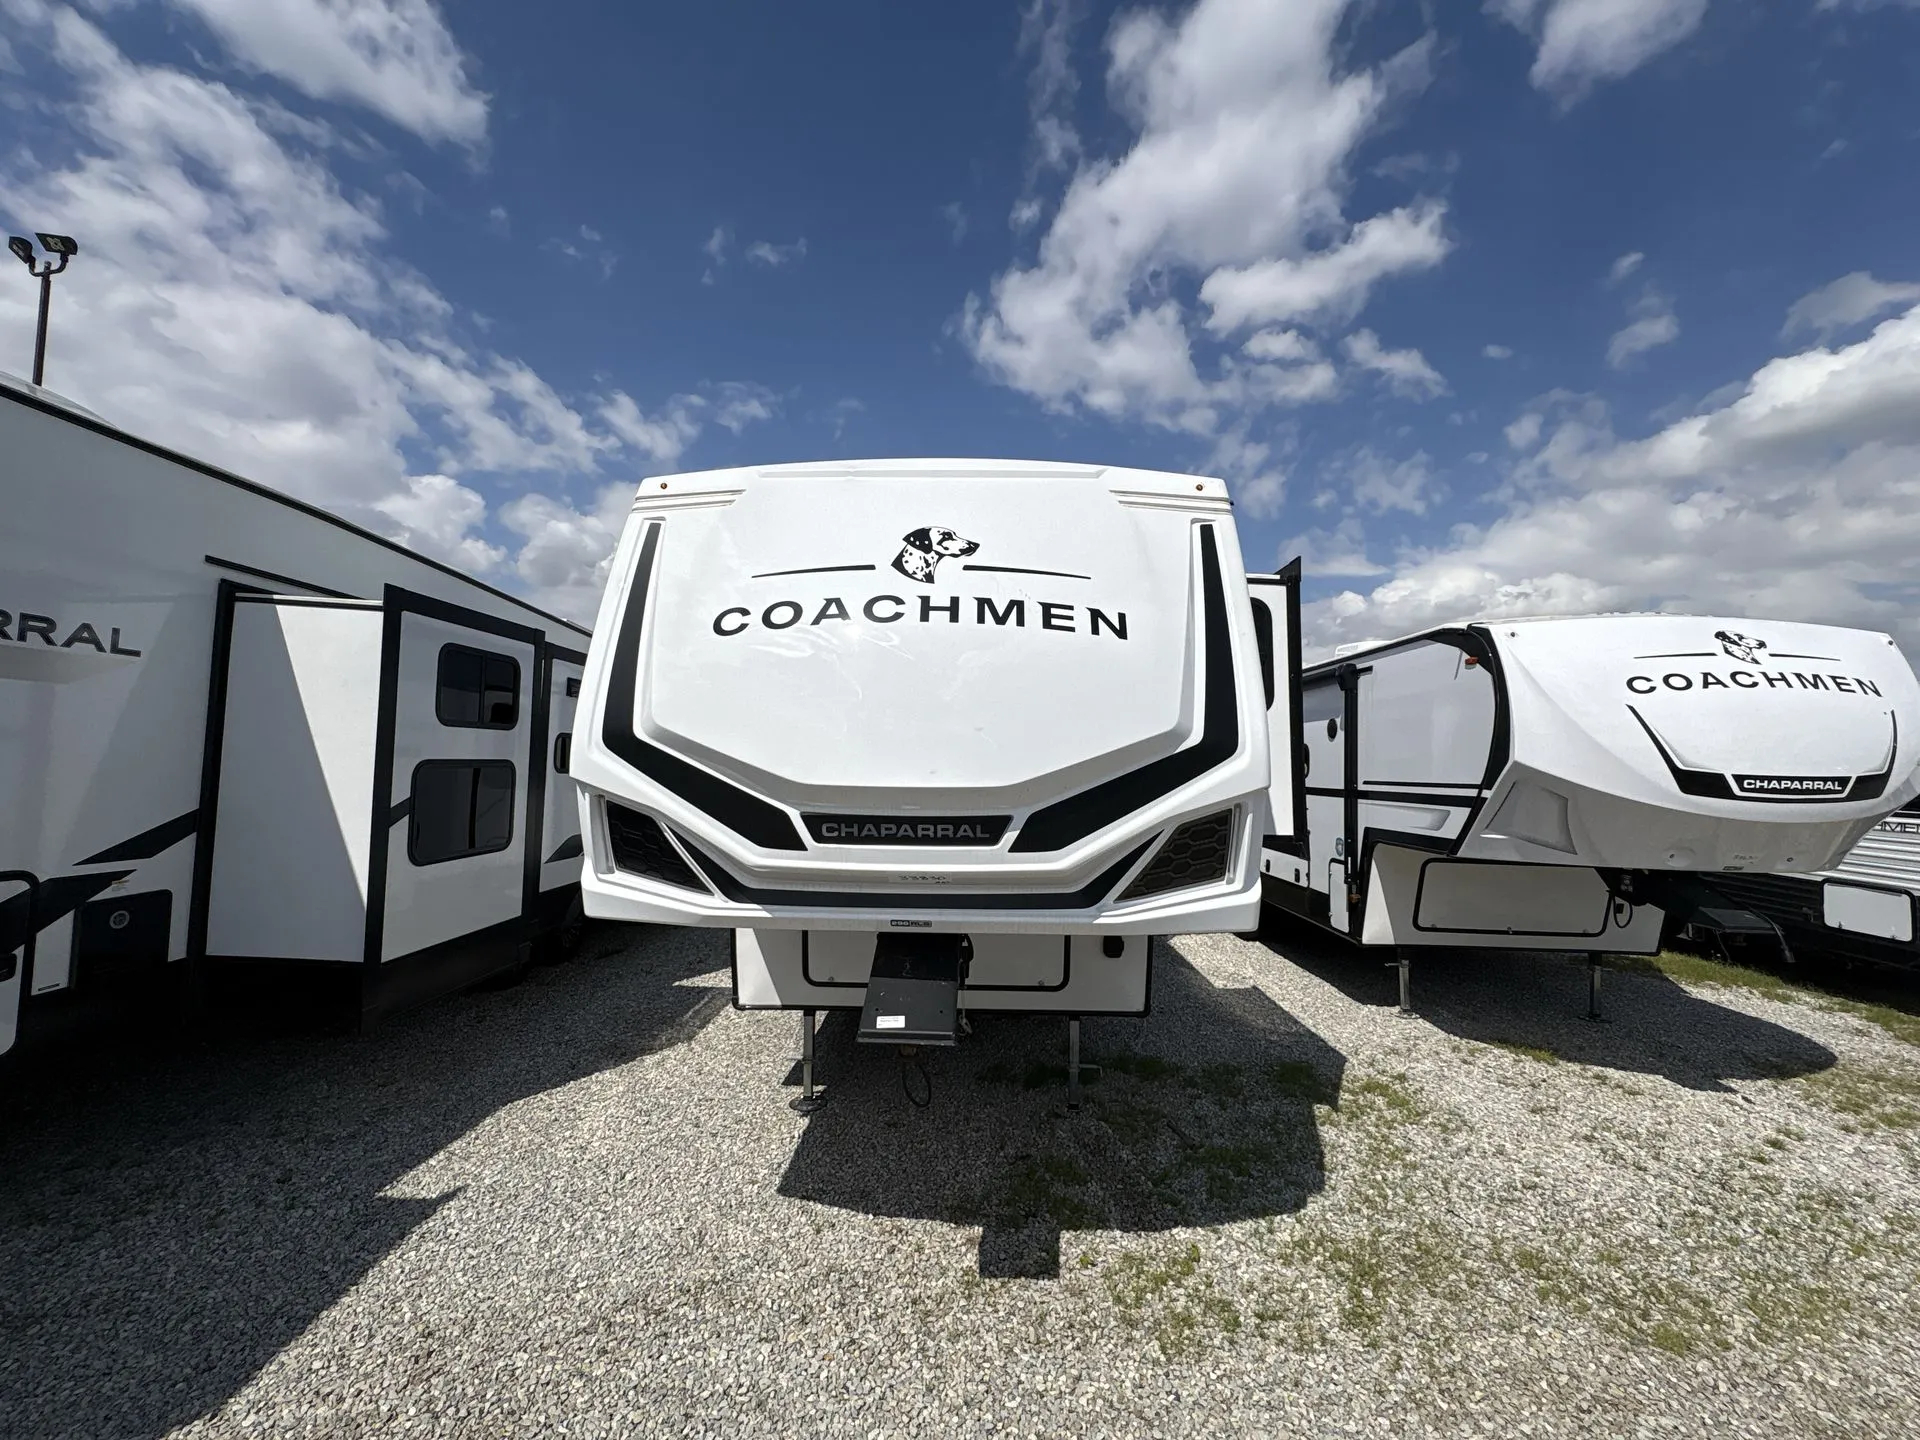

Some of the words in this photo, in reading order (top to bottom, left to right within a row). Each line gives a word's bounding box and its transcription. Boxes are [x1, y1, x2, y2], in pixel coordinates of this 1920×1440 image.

[713, 594, 1128, 641] COACHMEN
[1625, 671, 1883, 698] COACHMEN
[1742, 778, 1843, 791] CHAPARRAL
[821, 823, 990, 838] CHAPARRAL
